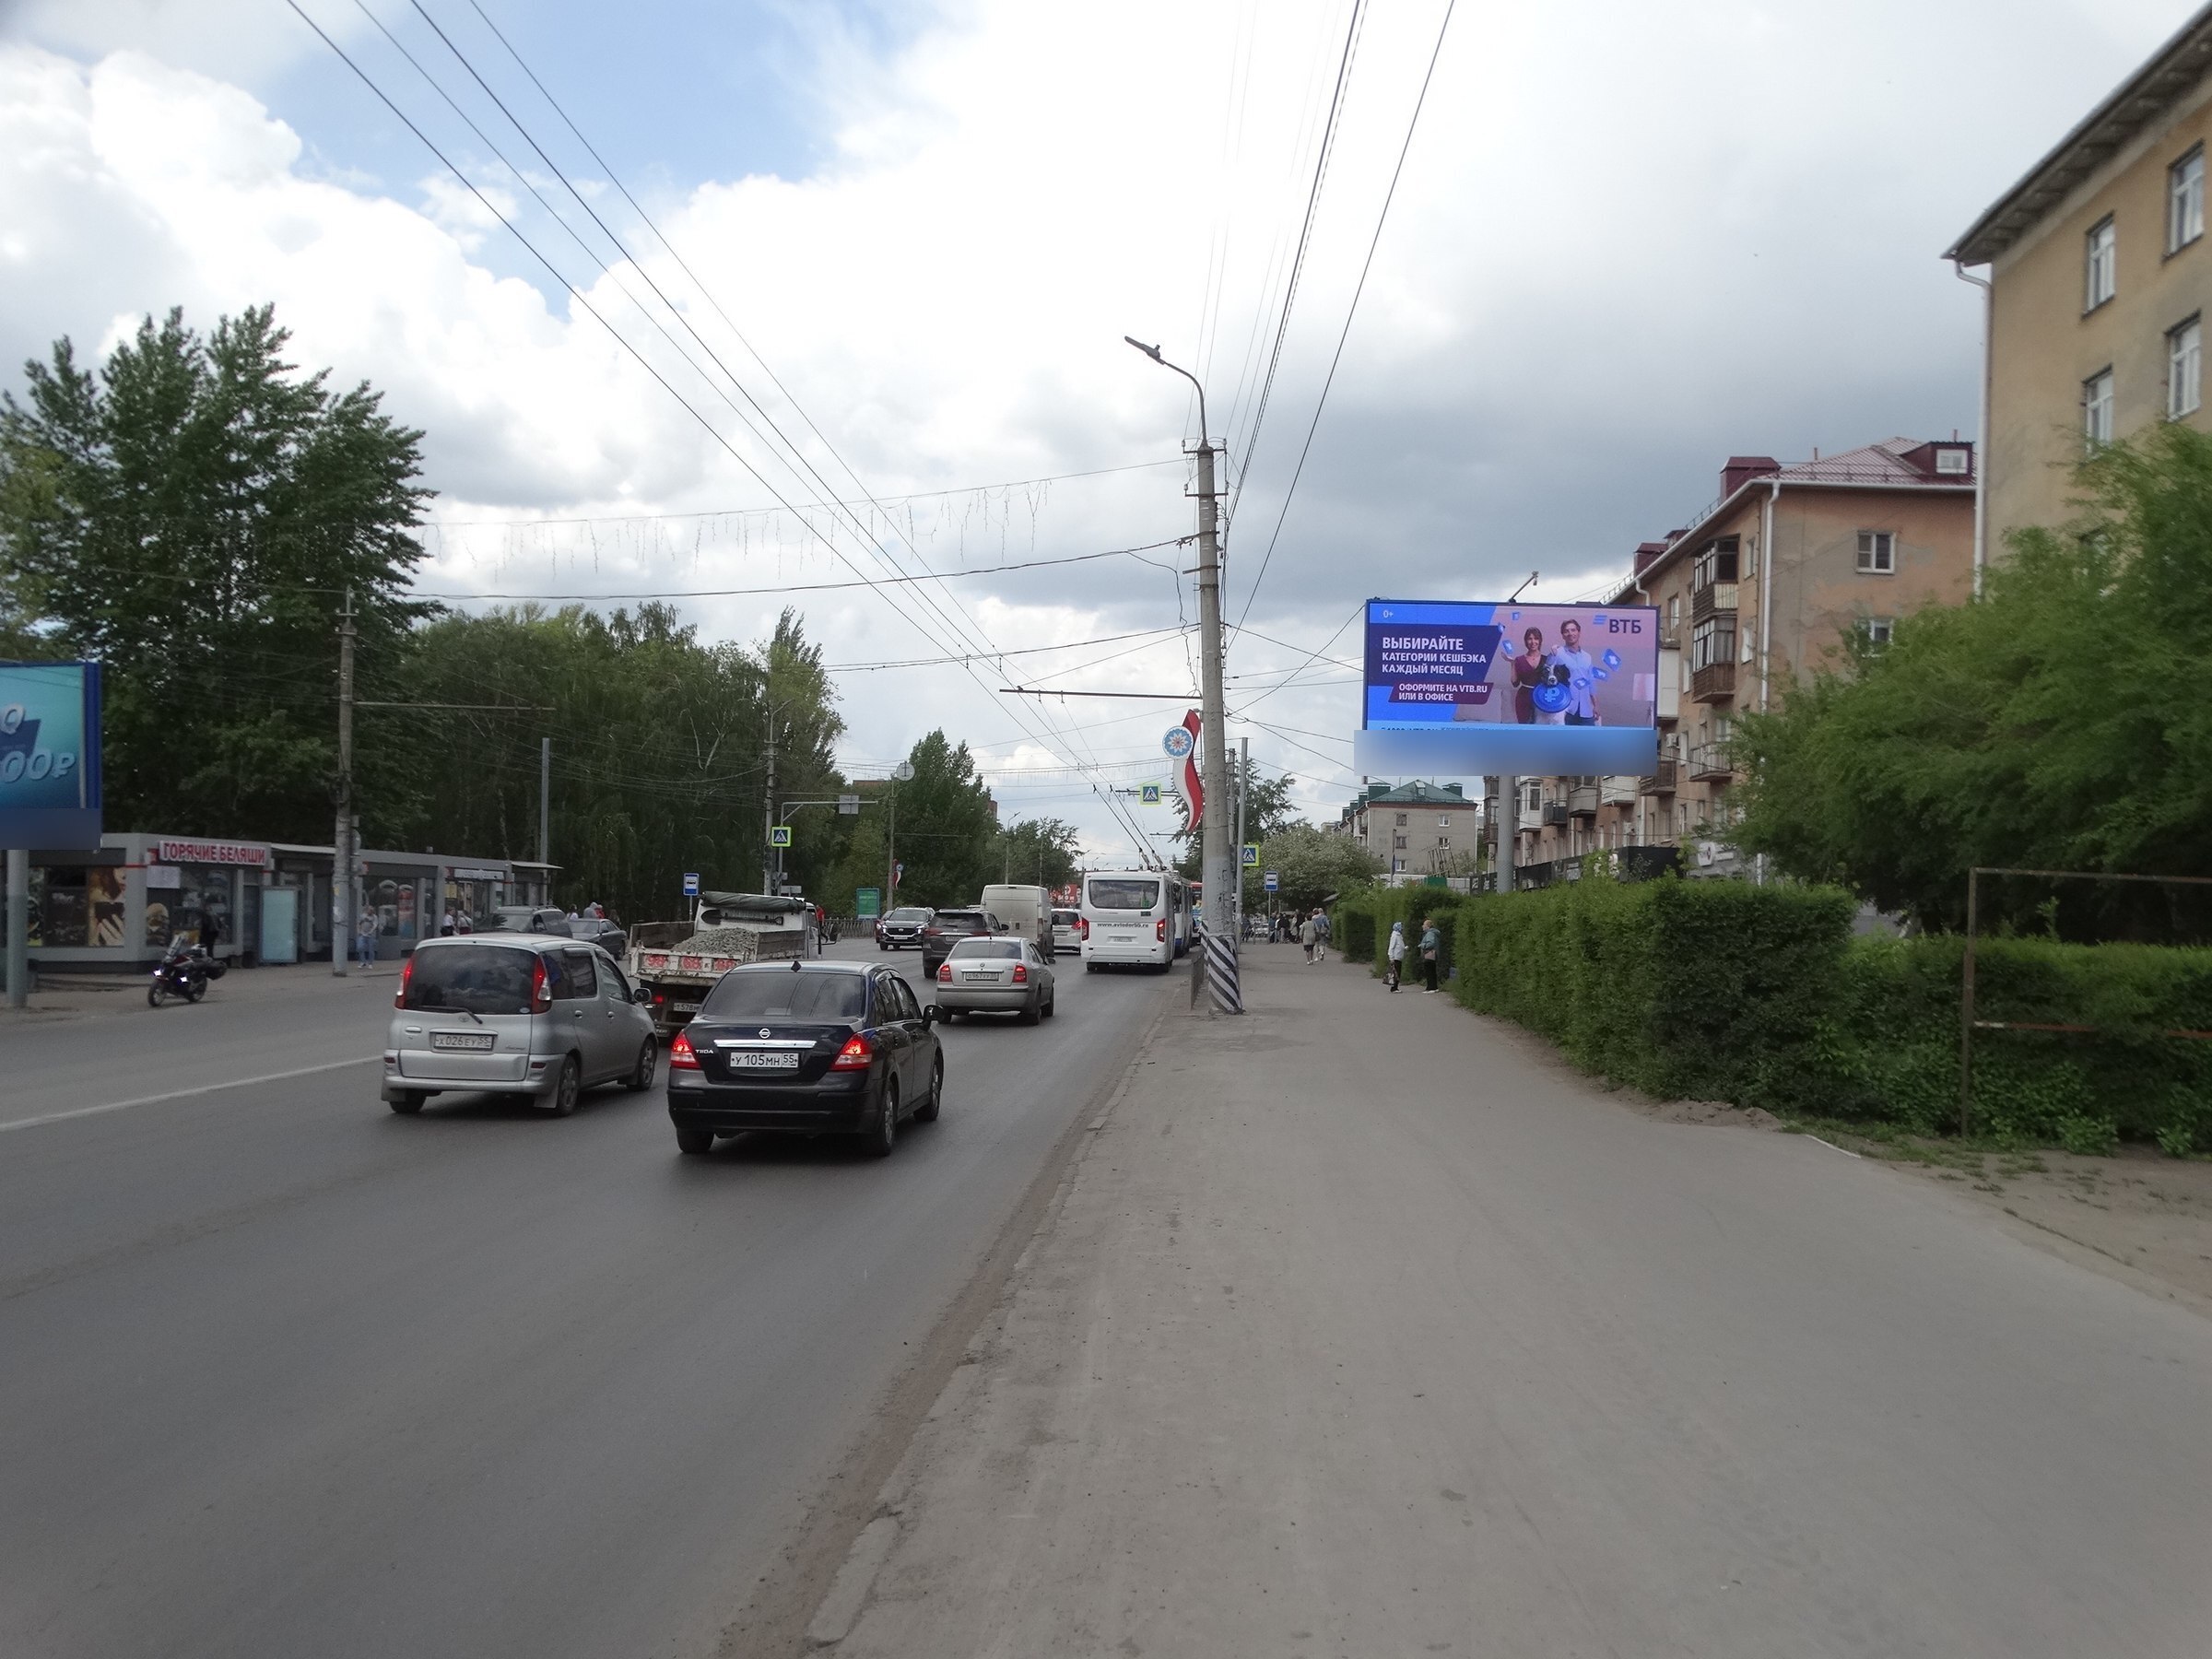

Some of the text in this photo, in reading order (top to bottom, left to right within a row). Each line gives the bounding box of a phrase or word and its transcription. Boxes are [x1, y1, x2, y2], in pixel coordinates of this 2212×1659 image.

[1382, 610, 1394, 618] 0+
[1608, 618, 1641, 634] ВТБ
[1382, 635, 1464, 651] ВЫБИРАЙТЕ
[1382, 652, 1487, 664] КАТЕГОРИИ КЕШБЭКА
[1382, 664, 1464, 676] КАЖДЫЙ МЕСЯЦ
[1398, 683, 1488, 693] ОФОРМИТЕ НА VTB.RU
[1398, 693, 1453, 701] ИЛИ В ОФИСЕ
[163, 842, 265, 863] ГОРЯЧИЕ БЕЛЯШИ
